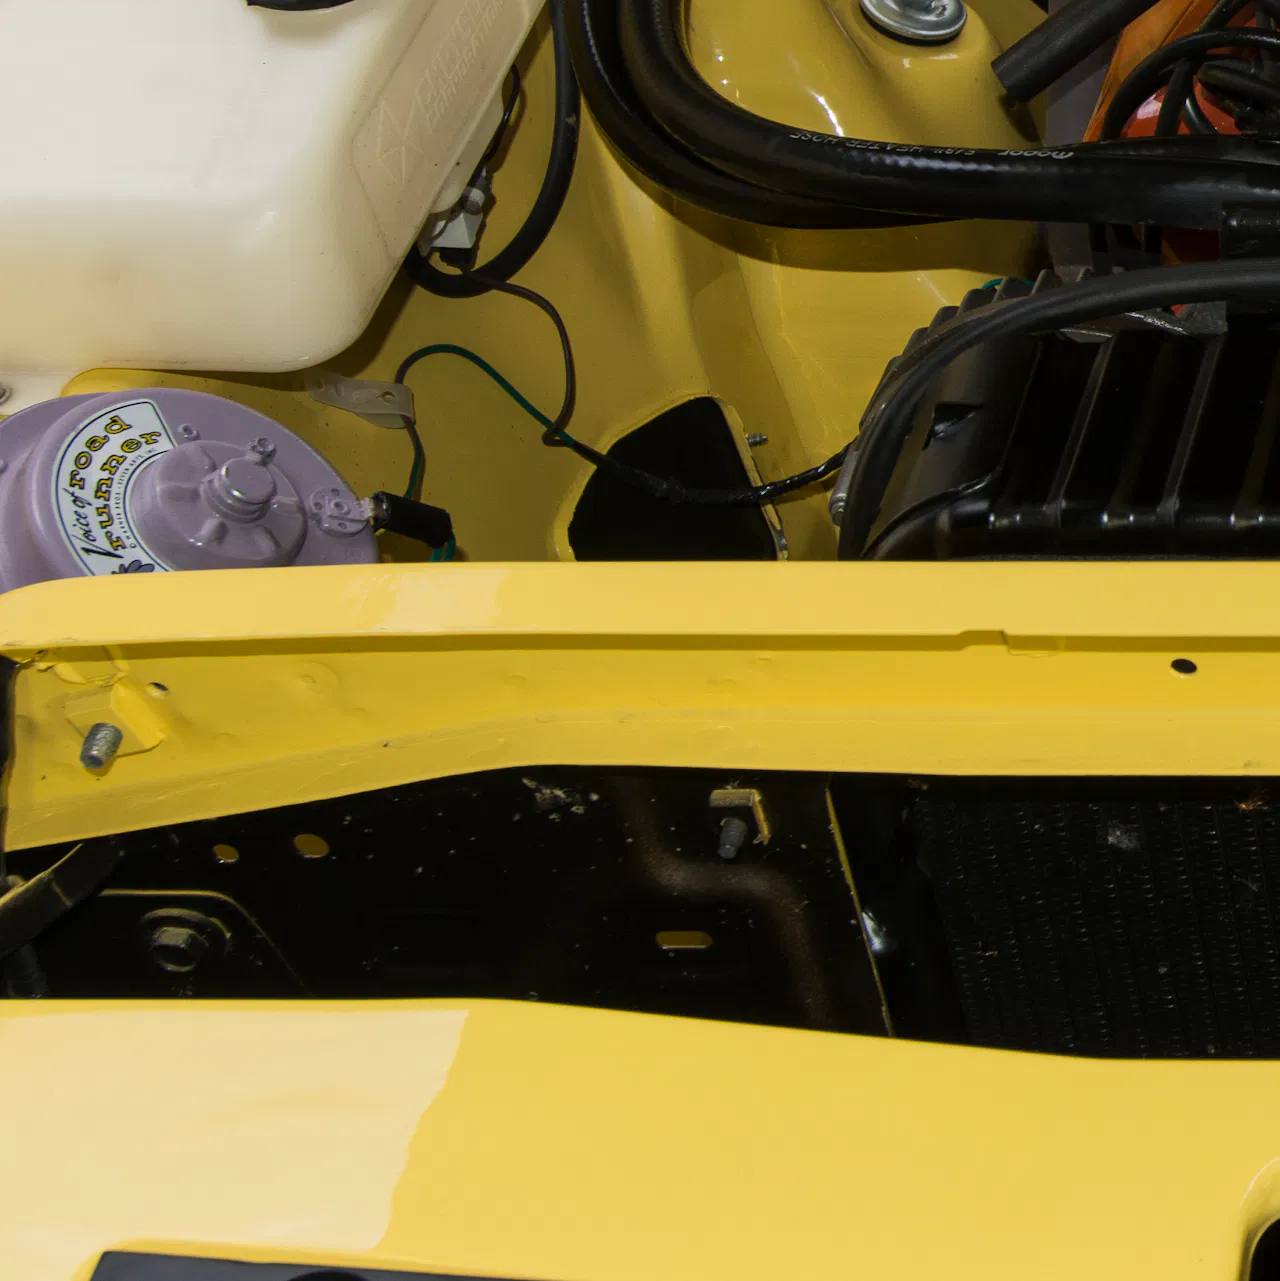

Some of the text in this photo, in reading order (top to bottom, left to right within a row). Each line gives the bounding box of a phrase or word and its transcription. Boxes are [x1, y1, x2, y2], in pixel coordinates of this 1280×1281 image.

[789, 130, 840, 146] HOSE
[69, 415, 133, 491] road
[95, 431, 161, 551] runner
[71, 510, 124, 559] Voice
